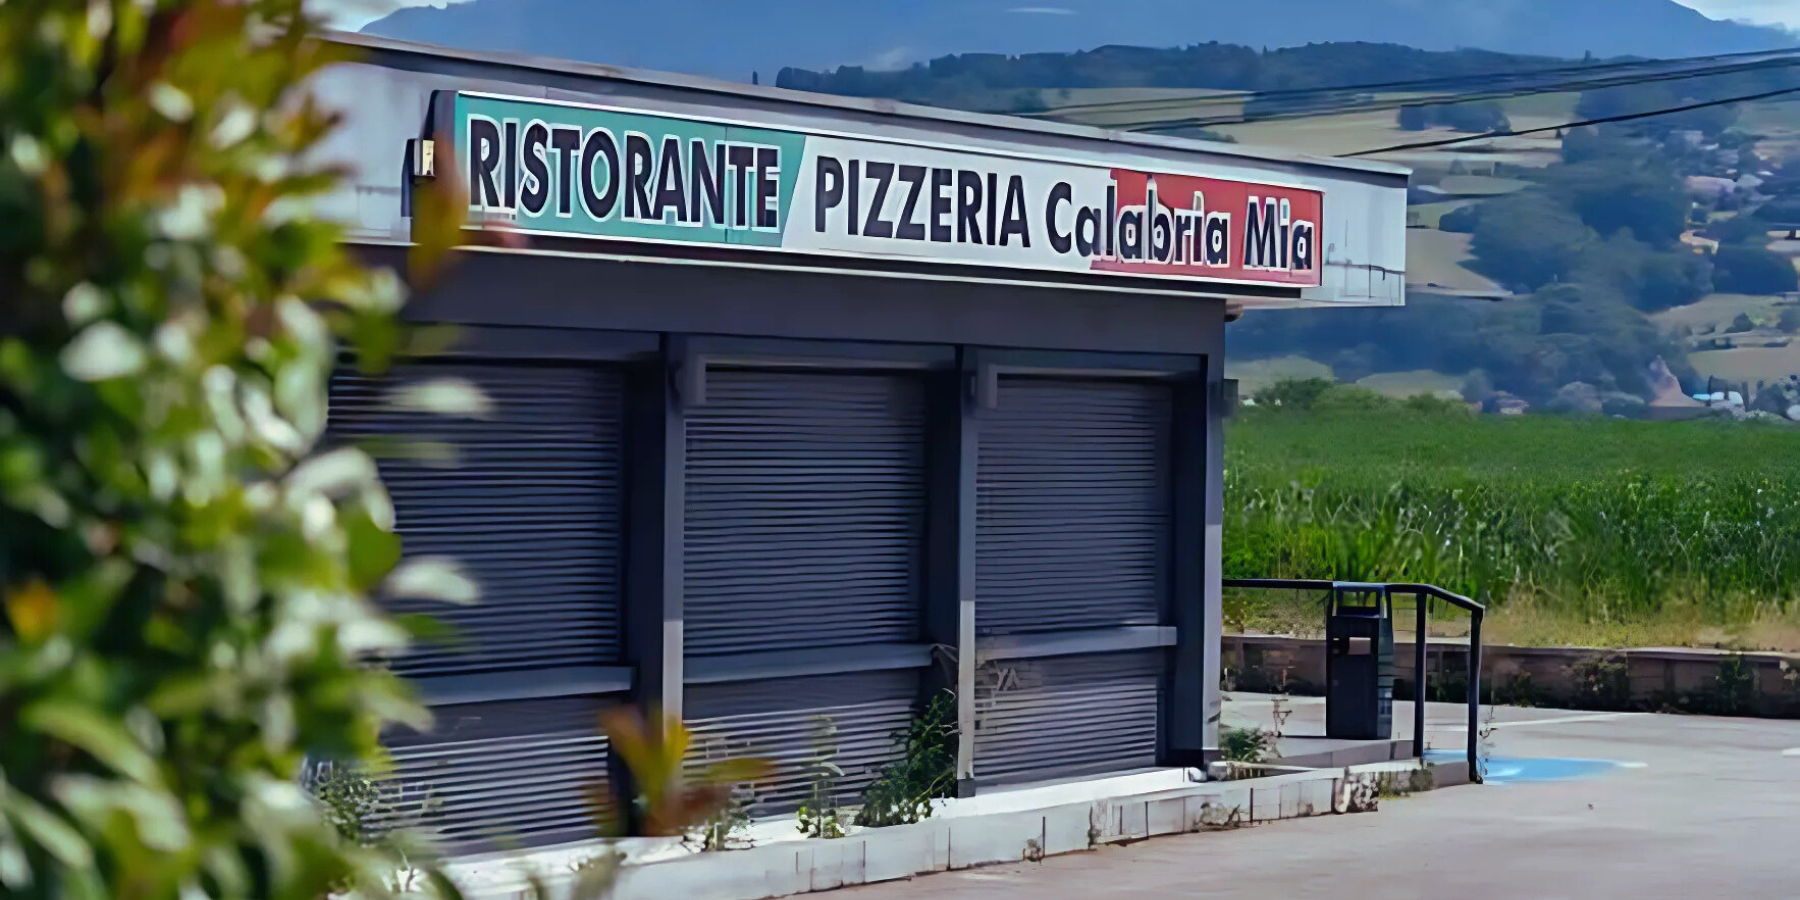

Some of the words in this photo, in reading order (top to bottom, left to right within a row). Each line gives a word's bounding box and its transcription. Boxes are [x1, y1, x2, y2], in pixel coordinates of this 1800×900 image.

[469, 117, 780, 230] RISTORANTE
[815, 155, 1031, 248] PIZZERIA
[1046, 180, 1230, 267] Calabria
[1243, 197, 1314, 271] Mia
